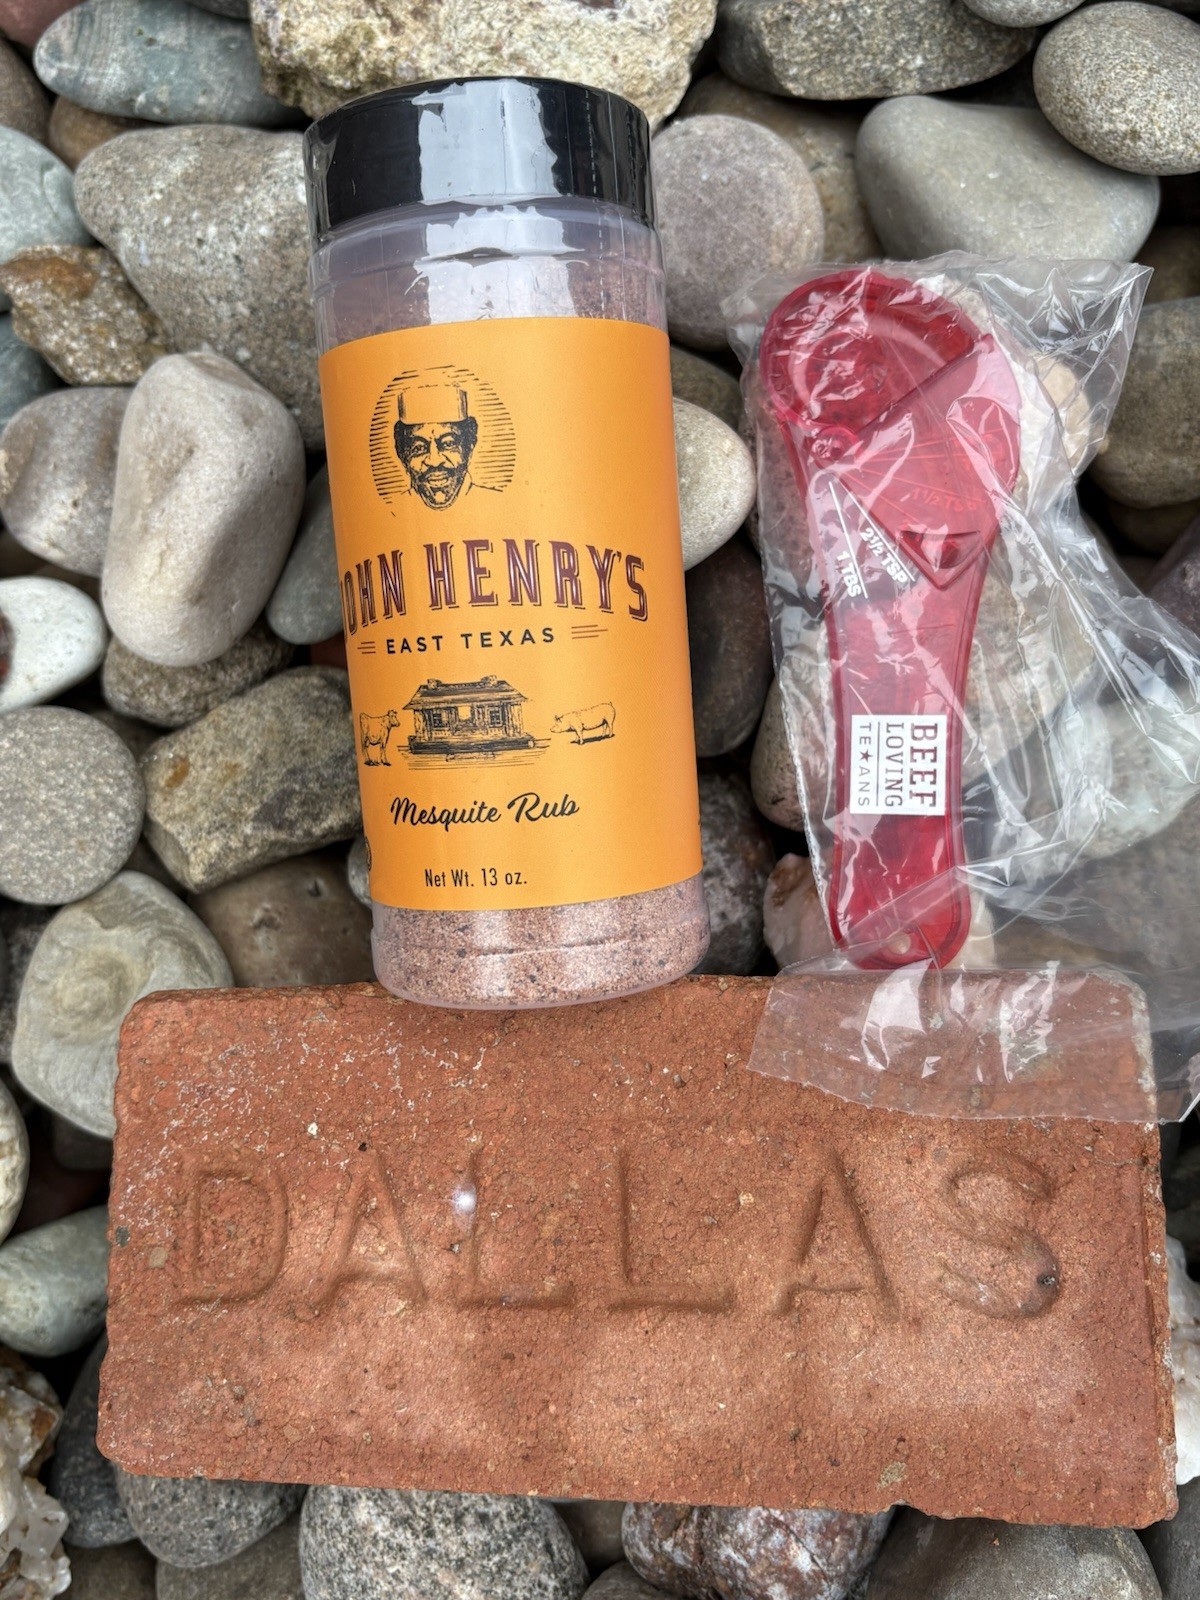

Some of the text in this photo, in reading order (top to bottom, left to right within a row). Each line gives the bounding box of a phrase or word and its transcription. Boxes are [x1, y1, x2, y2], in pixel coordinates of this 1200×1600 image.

[340, 538, 649, 642] OHN HENRY'S
[836, 550, 862, 598] 1 TBS
[880, 552, 908, 583] TSP
[386, 627, 556, 655] EAST TEXAS
[884, 722, 905, 808] LOVING
[909, 722, 939, 808] BEEF
[389, 792, 581, 832] Mesquite Rub
[424, 867, 528, 888] Net Wt. 13 oz.
[178, 1144, 1062, 1322] DALLAS
